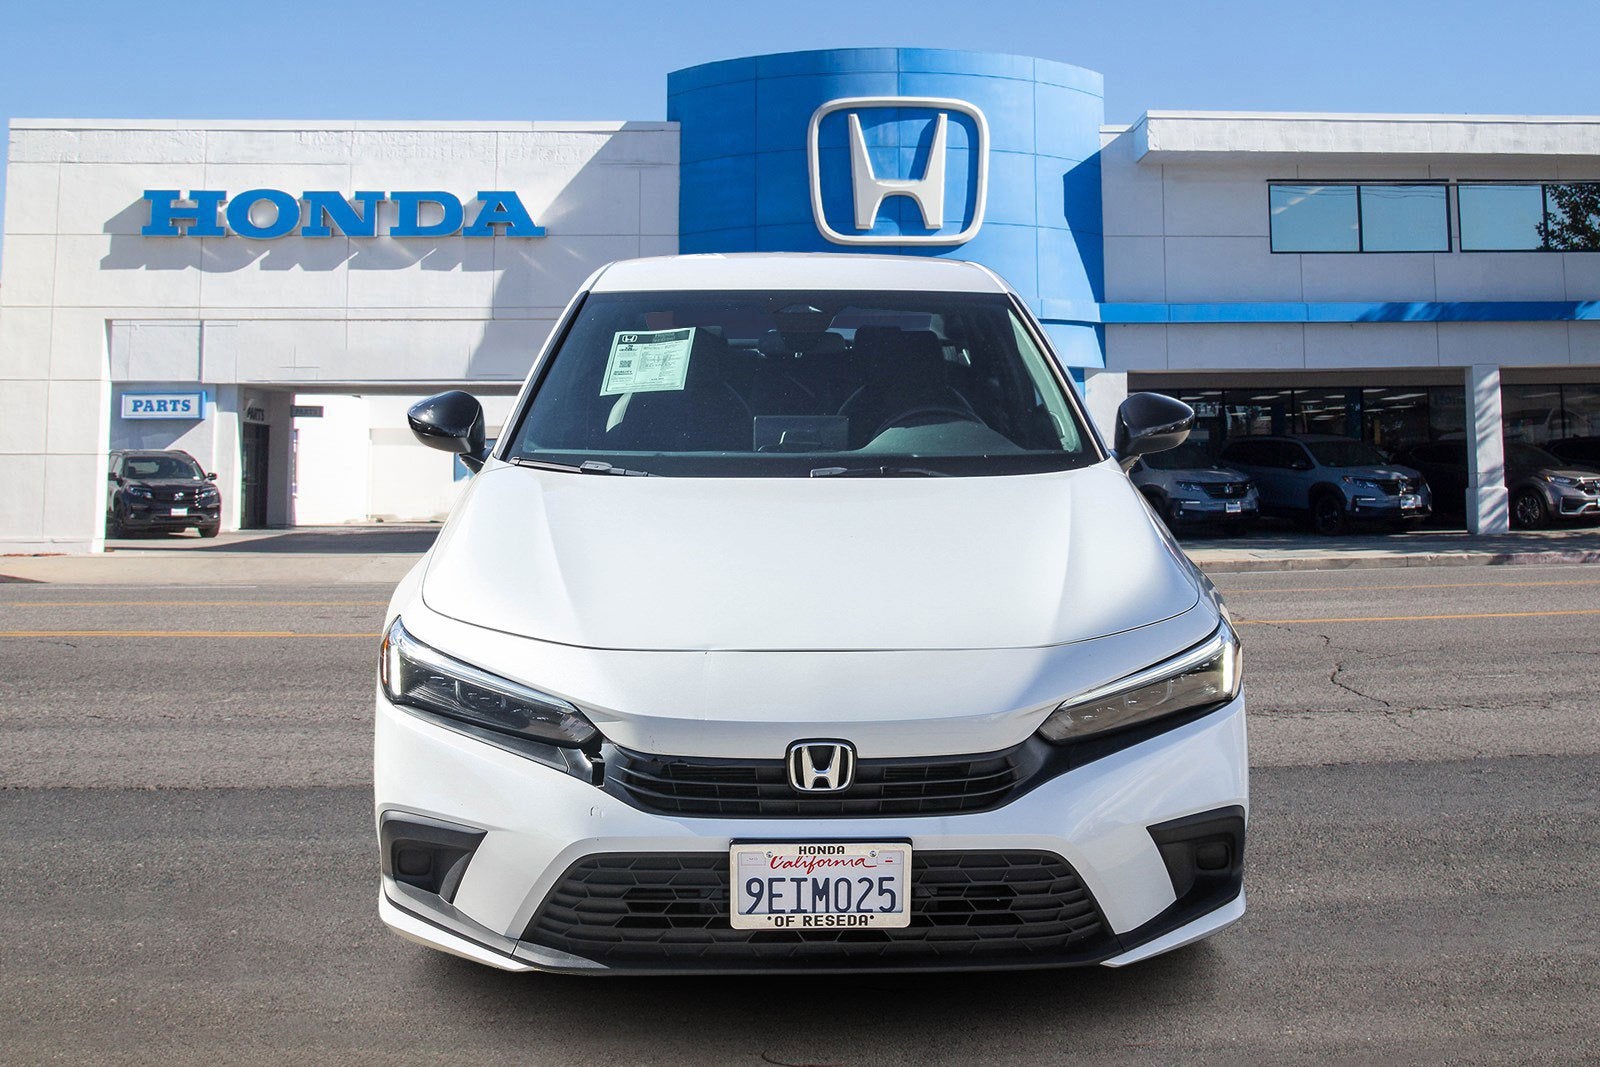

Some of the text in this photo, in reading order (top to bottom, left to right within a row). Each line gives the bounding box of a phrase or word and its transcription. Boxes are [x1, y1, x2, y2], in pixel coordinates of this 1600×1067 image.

[141, 188, 548, 240] HONDA
[131, 399, 191, 413] PARTS
[798, 845, 845, 855] HONDA
[769, 855, 877, 875] California
[745, 876, 897, 914] 9EIM025
[774, 914, 869, 927] OF RESEDA
